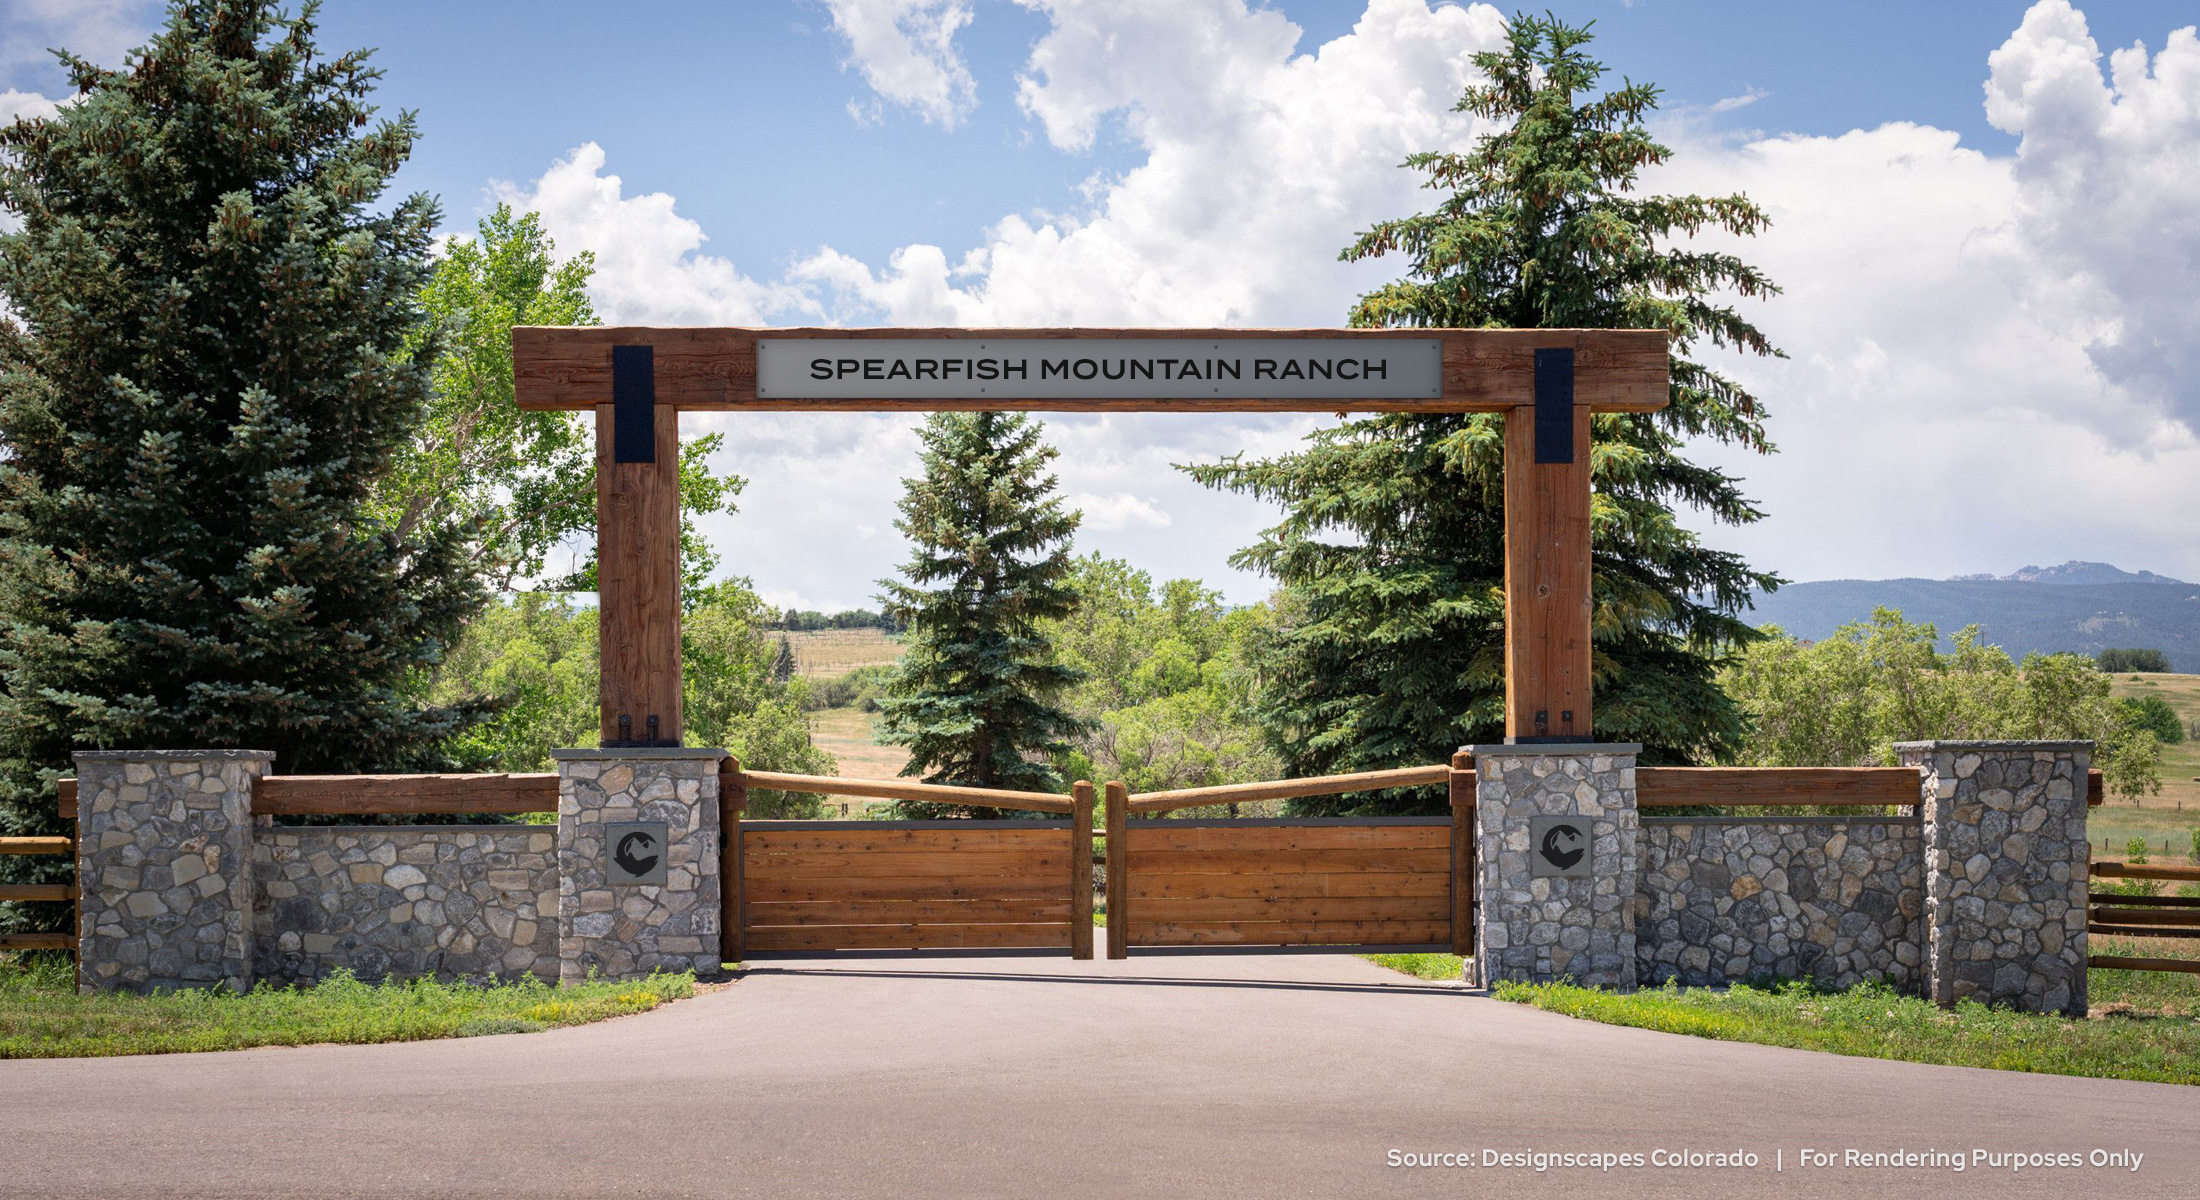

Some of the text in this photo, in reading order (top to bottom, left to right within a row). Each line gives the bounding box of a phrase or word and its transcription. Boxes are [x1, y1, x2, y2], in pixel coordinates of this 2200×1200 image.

[809, 358, 1387, 380] SPEARFISH MOUNTAIN RANCH
